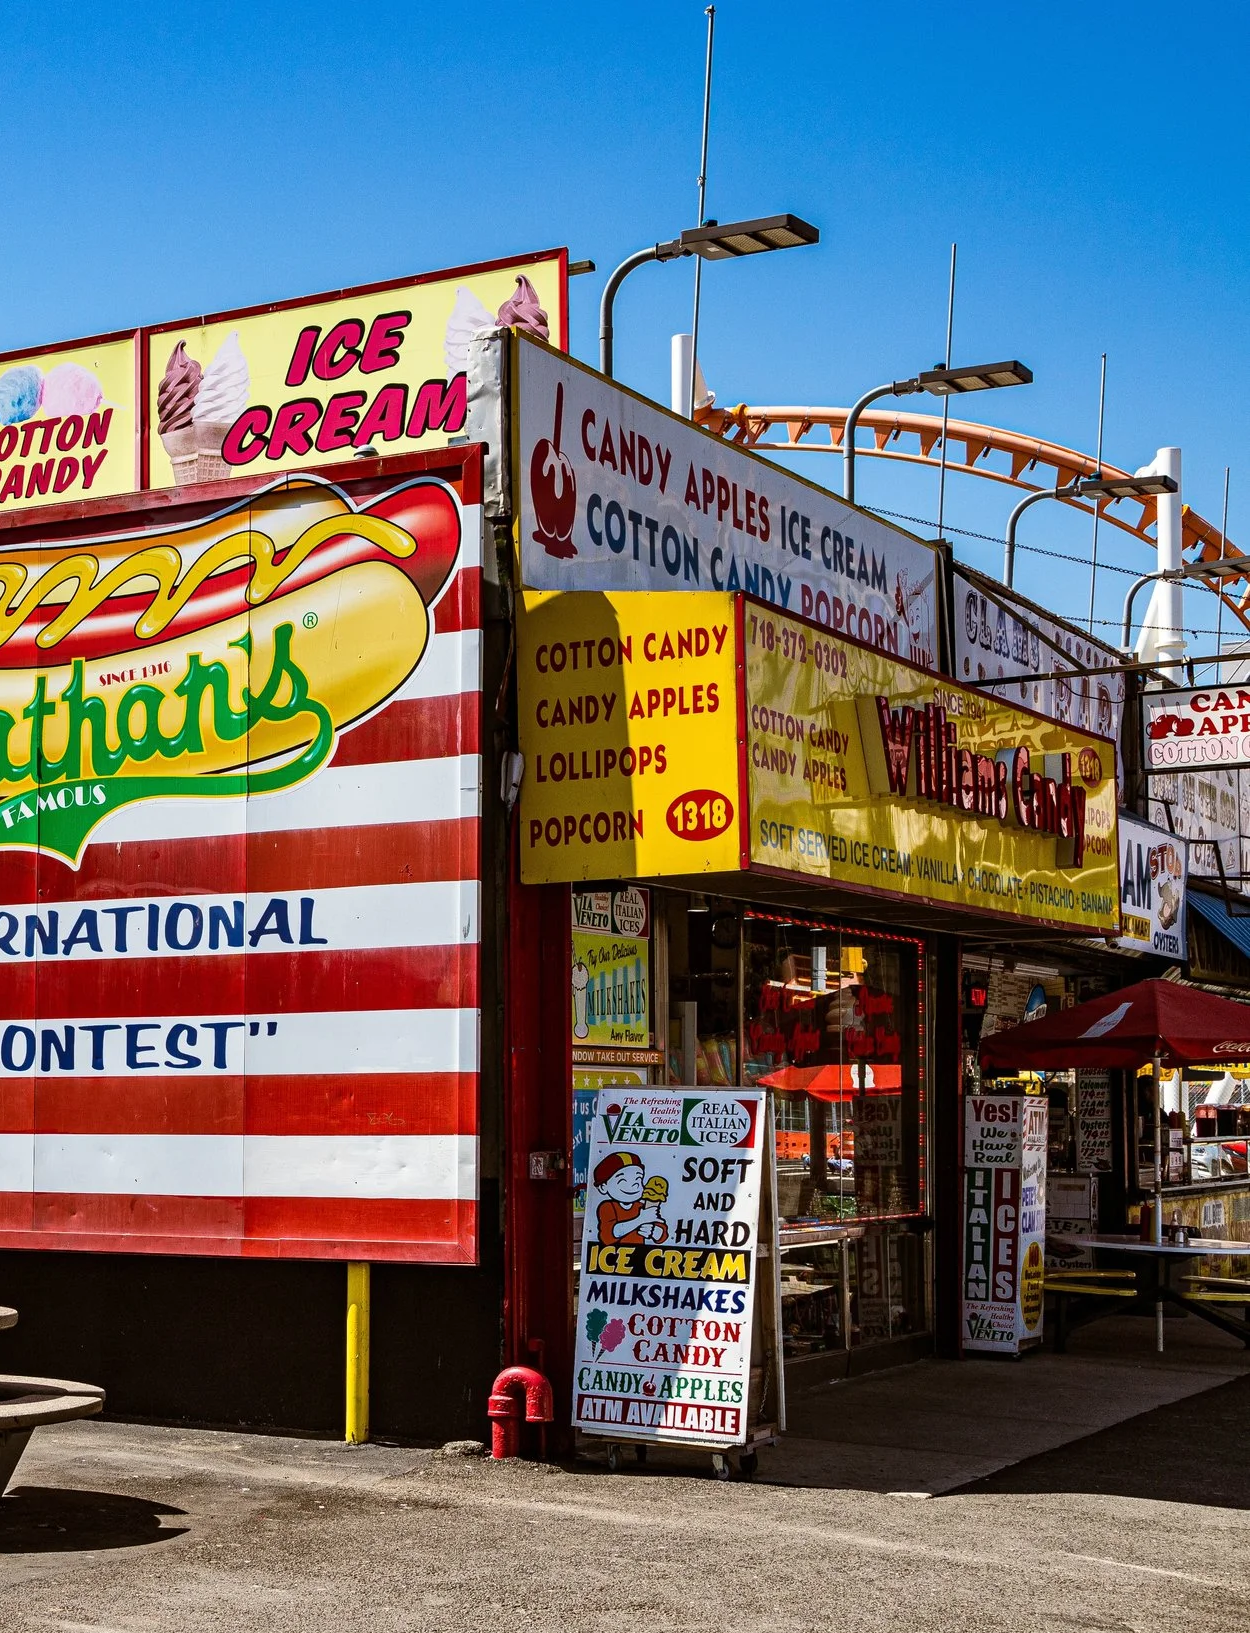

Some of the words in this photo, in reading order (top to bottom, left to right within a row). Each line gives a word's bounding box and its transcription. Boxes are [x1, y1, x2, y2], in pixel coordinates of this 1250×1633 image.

[285, 310, 412, 387] ICE
[221, 371, 467, 466] CREAM
[581, 408, 671, 494] CANDY
[684, 460, 770, 543] APPLES
[781, 505, 812, 561] ICE
[820, 525, 887, 595] CREAM
[586, 493, 700, 586] COTTON
[710, 546, 791, 610] CANDY
[801, 583, 898, 655] POPCORN
[965, 589, 1040, 673] CLAMS
[536, 635, 633, 673] COTTON
[643, 624, 728, 662] CANDY
[751, 615, 848, 679] 718-372-0302
[99, 669, 138, 688] SINCE
[141, 660, 172, 681] 1916
[536, 692, 616, 728] CANDY
[628, 682, 719, 720] APPLES
[933, 687, 963, 714] SINCE
[965, 701, 987, 724] 1941
[751, 705, 804, 743] COTTON
[809, 722, 849, 757] CANDY
[536, 744, 667, 782] LOLLIPOPS
[1148, 736, 1239, 765] COTTON
[752, 743, 797, 777] CANDY
[803, 759, 846, 792] APPLES
[875, 695, 1007, 819] Williams
[1012, 746, 1087, 868] Candy
[1, 783, 107, 829] FAMOUS
[672, 798, 727, 831] 1318
[1085, 807, 1111, 830] IPOPS
[530, 809, 644, 848] POPCORN
[1083, 834, 1112, 857] PCORN
[760, 819, 794, 848] SOFT
[798, 827, 848, 863] SERVED
[850, 840, 870, 868] ICE
[872, 846, 916, 878] CREAM:
[916, 856, 959, 886] VANILLA
[967, 866, 1023, 900] CHOCOLATE
[1030, 882, 1074, 910] PISTACHIO
[1081, 892, 1113, 916] BANANA
[1121, 838, 1151, 911] AM
[615, 904, 644, 919] ITALIAN
[620, 891, 639, 904] REAL
[619, 919, 640, 932] ICES
[587, 949, 597, 969] Try
[612, 943, 637, 961] Delicious
[587, 978, 646, 1016] MILKSHAKES
[610, 1028, 624, 1043] Any
[625, 1029, 644, 1043] Flavor
[597, 1051, 614, 1062] TAKE
[617, 1052, 631, 1063] OUT
[632, 1052, 658, 1063] SERVICE
[624, 1097, 638, 1105] The
[640, 1097, 681, 1106] Refreshing
[650, 1107, 681, 1116] Healthy
[702, 1103, 739, 1115] REAL
[972, 1099, 1018, 1123] Yes!
[1080, 1100, 1110, 1108] CLAMS
[651, 1117, 680, 1125] Choice.
[691, 1116, 748, 1130] ITALIAN
[980, 1127, 1008, 1139] We
[1080, 1119, 1110, 1131] Oysters
[700, 1131, 738, 1144] ICES
[972, 1139, 1017, 1151] Have
[1081, 1140, 1111, 1148] CLAMS
[682, 1157, 754, 1184] SOFT
[974, 1152, 1015, 1163] Real
[693, 1192, 735, 1212] AND
[675, 1219, 750, 1247] HARD
[968, 1171, 988, 1299] ITALIAN
[996, 1172, 1016, 1299] ICES
[589, 1245, 636, 1274] ICE
[645, 1249, 746, 1281] CREAM
[1059, 1259, 1093, 1269] Oysters
[586, 1281, 746, 1314] MILKSHAKES
[966, 1303, 977, 1311] The
[979, 1304, 1014, 1313] Refreshing
[627, 1313, 742, 1343] COTTON
[991, 1313, 1014, 1322] Healthy
[632, 1340, 728, 1367] CANDY
[578, 1367, 643, 1394] CANDY
[658, 1374, 743, 1403] APPLES
[581, 1398, 623, 1422] ATM
[627, 1402, 737, 1433] AVAILABLE
